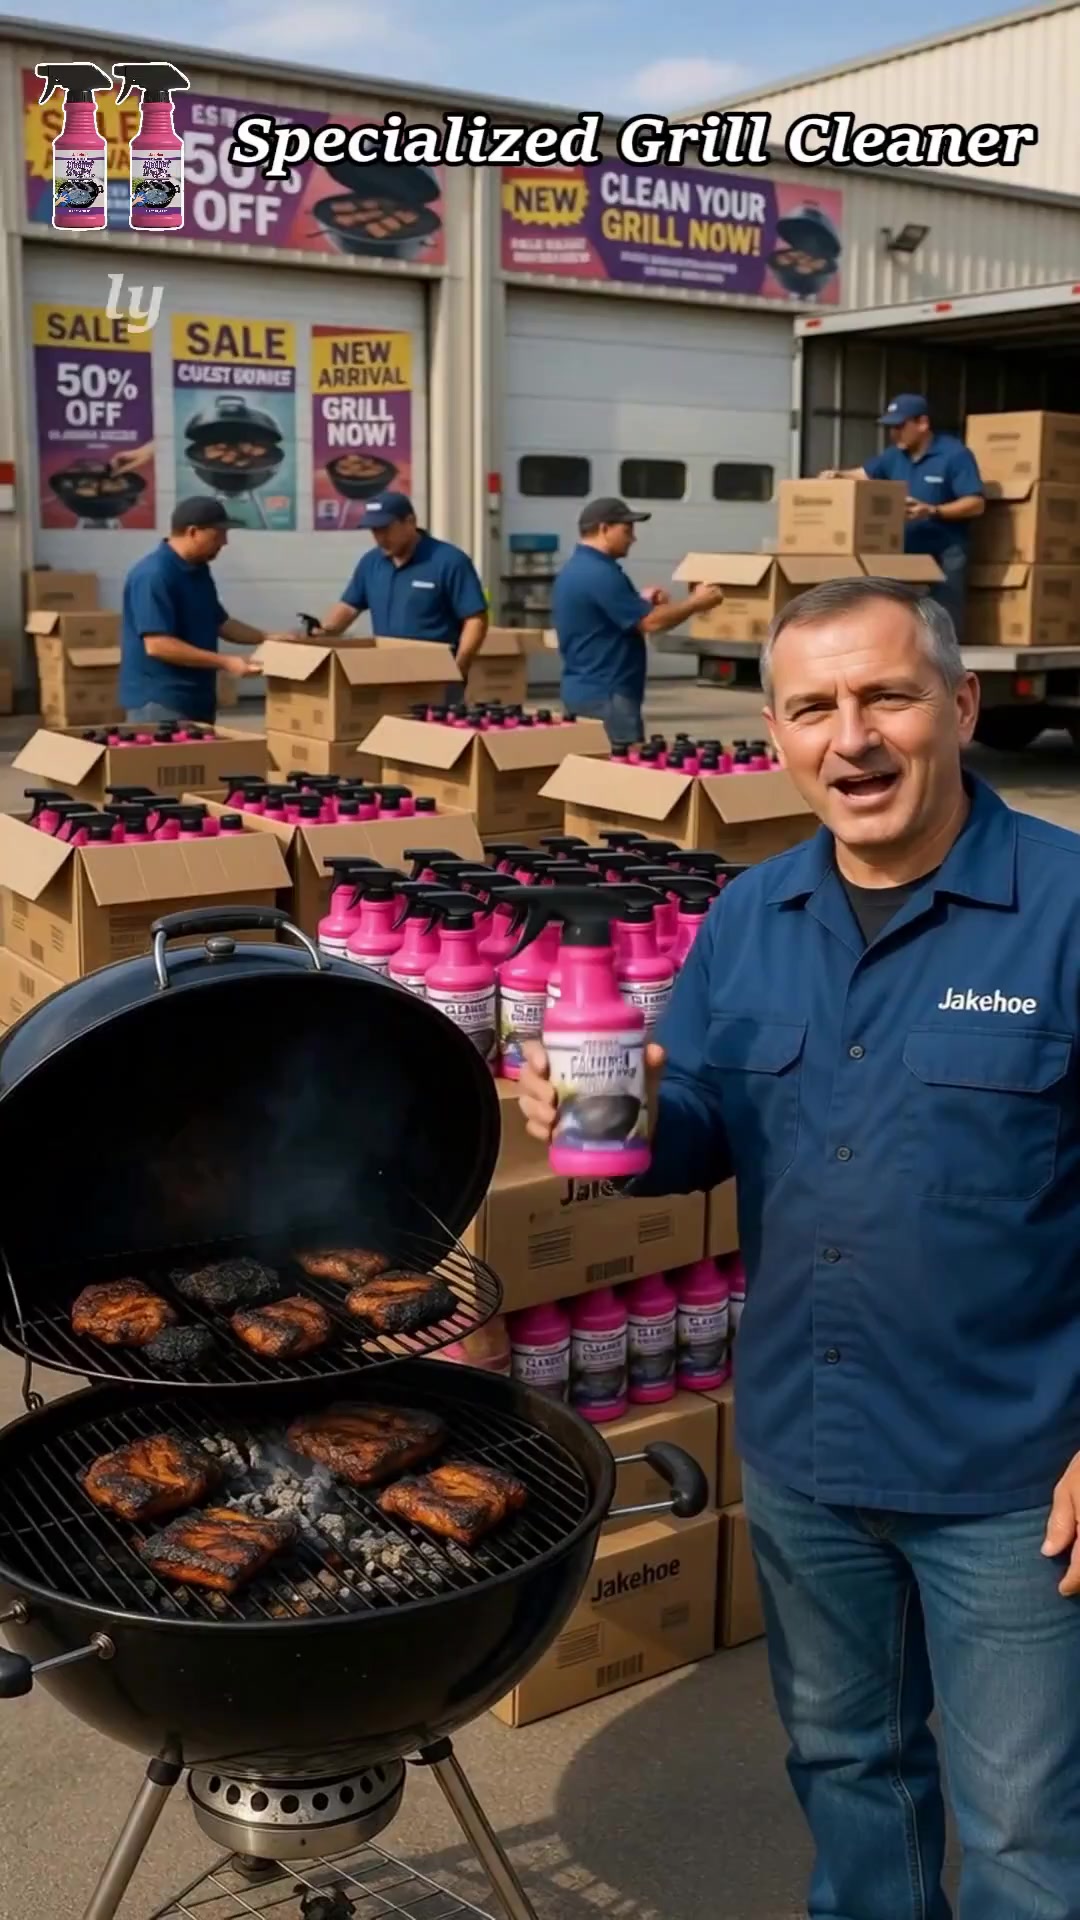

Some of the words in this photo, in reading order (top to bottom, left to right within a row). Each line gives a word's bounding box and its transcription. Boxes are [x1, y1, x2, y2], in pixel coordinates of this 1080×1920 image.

[513, 184, 578, 213] NEW
[601, 172, 690, 214] CLEAN
[695, 184, 765, 223] YOUR
[193, 190, 282, 236] OFF
[601, 208, 683, 248] GRILL
[688, 218, 762, 257] NOW!
[47, 313, 130, 344] SALE
[186, 320, 287, 360] SALE
[331, 341, 391, 365] NEW
[57, 362, 138, 400] 50%
[318, 366, 407, 389] ARRIVAL
[65, 400, 123, 427] OFF
[322, 396, 393, 421] GRILL
[327, 421, 396, 446] NOW!
[937, 986, 1037, 1015] Jakehoe
[591, 1558, 681, 1603] Jakehoe
